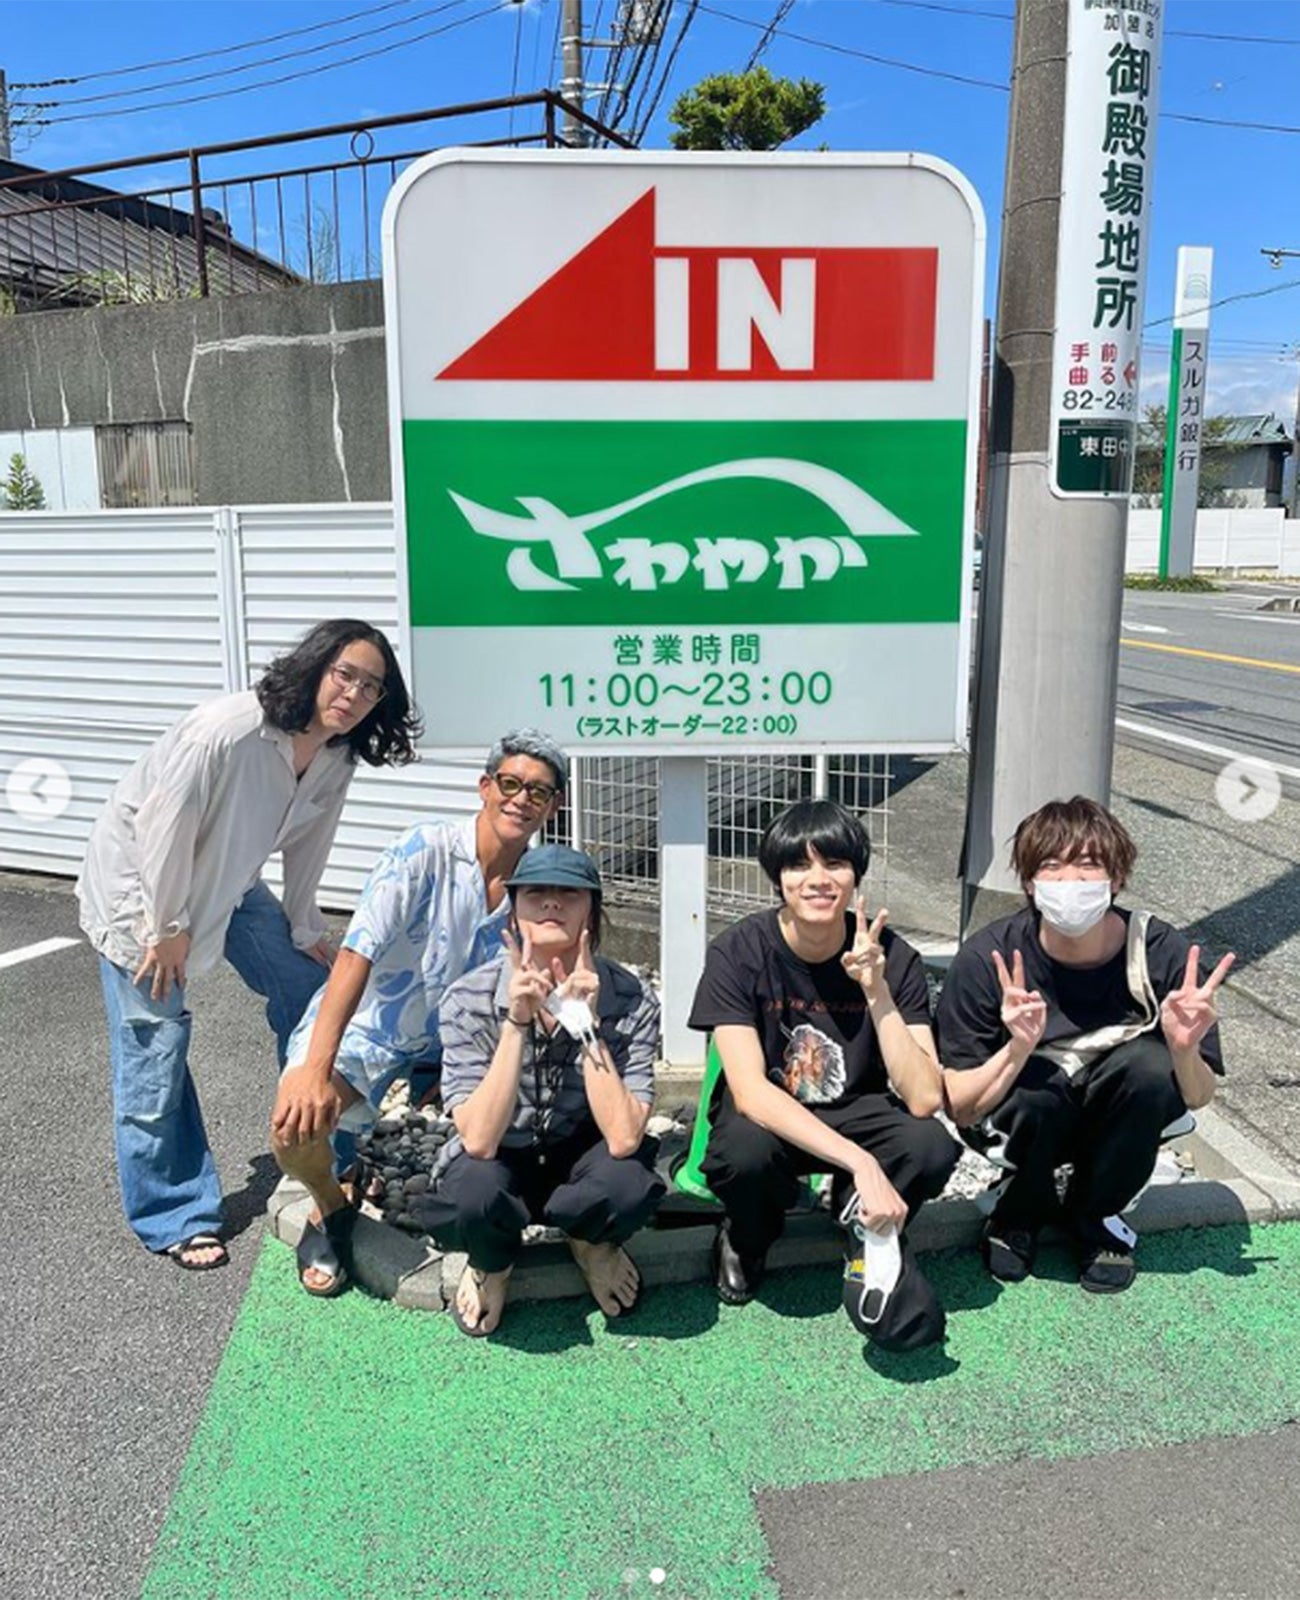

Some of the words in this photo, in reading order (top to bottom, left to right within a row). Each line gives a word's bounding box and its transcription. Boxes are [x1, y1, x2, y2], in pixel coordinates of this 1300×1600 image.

[1093, 42, 1150, 331] 御殿場地所
[654, 257, 817, 371] IN
[1178, 341, 1203, 471] スルガ銀行
[446, 457, 921, 591] さわやか
[613, 634, 761, 665] 営業時間
